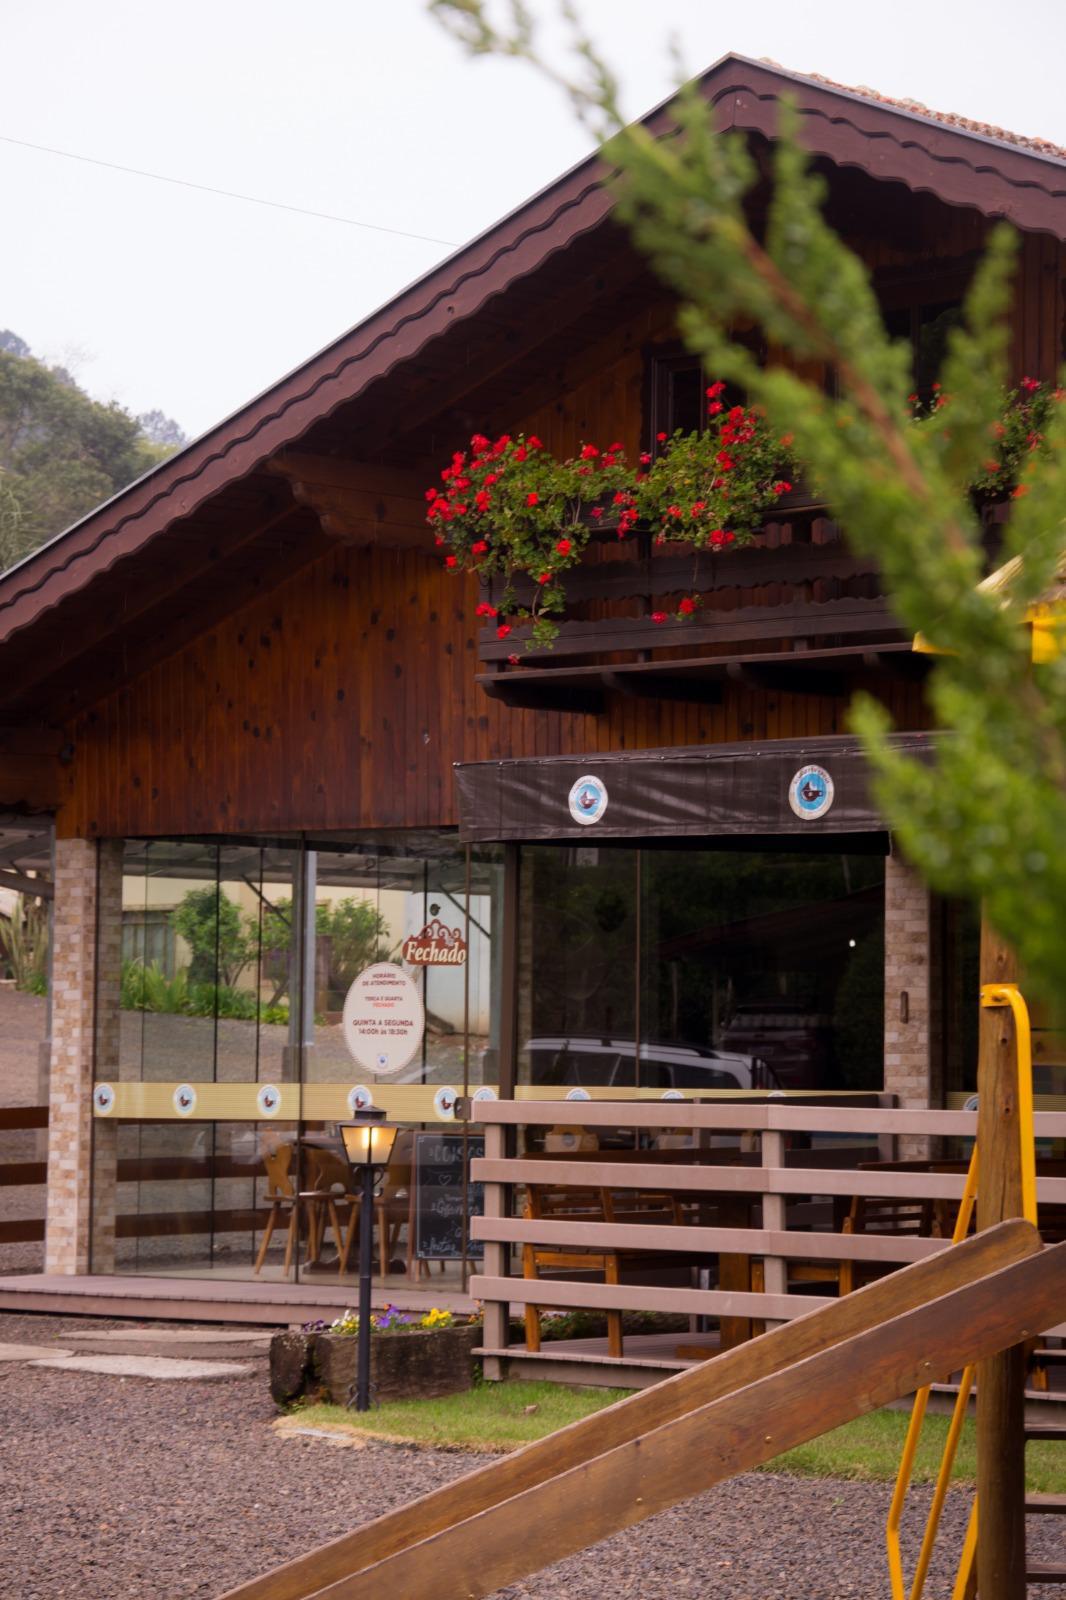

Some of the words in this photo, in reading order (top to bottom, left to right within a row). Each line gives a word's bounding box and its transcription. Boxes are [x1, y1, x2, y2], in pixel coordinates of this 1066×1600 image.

[406, 941, 466, 963] Fechado
[352, 1019, 376, 1027] QUINTA
[384, 1019, 414, 1027] SEGUNDA
